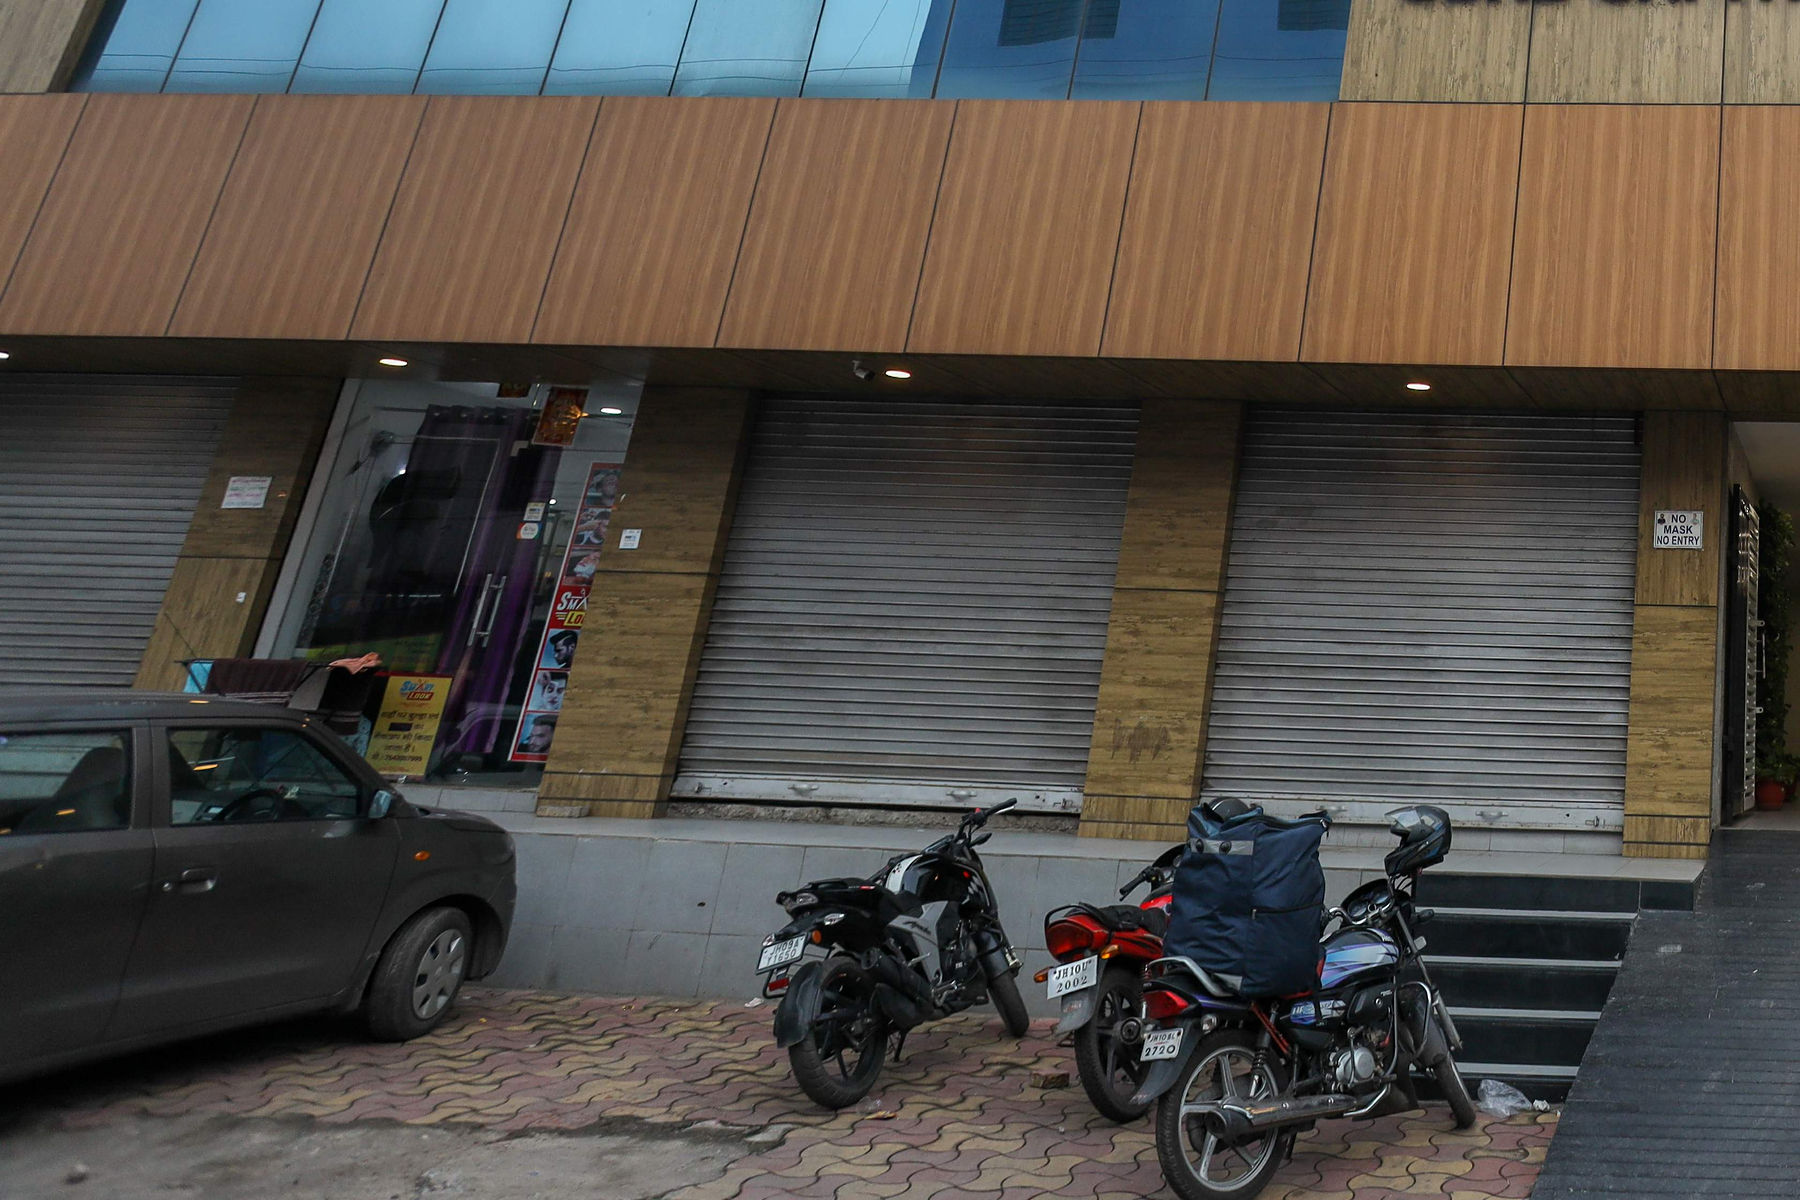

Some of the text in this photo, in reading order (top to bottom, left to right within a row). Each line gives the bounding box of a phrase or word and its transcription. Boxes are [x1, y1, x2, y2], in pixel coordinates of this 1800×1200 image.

[1671, 514, 1687, 524] NO
[1663, 525, 1693, 535] MASK
[1656, 535, 1700, 546] NO ENTRY
[1055, 961, 1089, 980] JH10U
[1055, 975, 1088, 994] 2002
[1145, 1044, 1176, 1057] 2720
